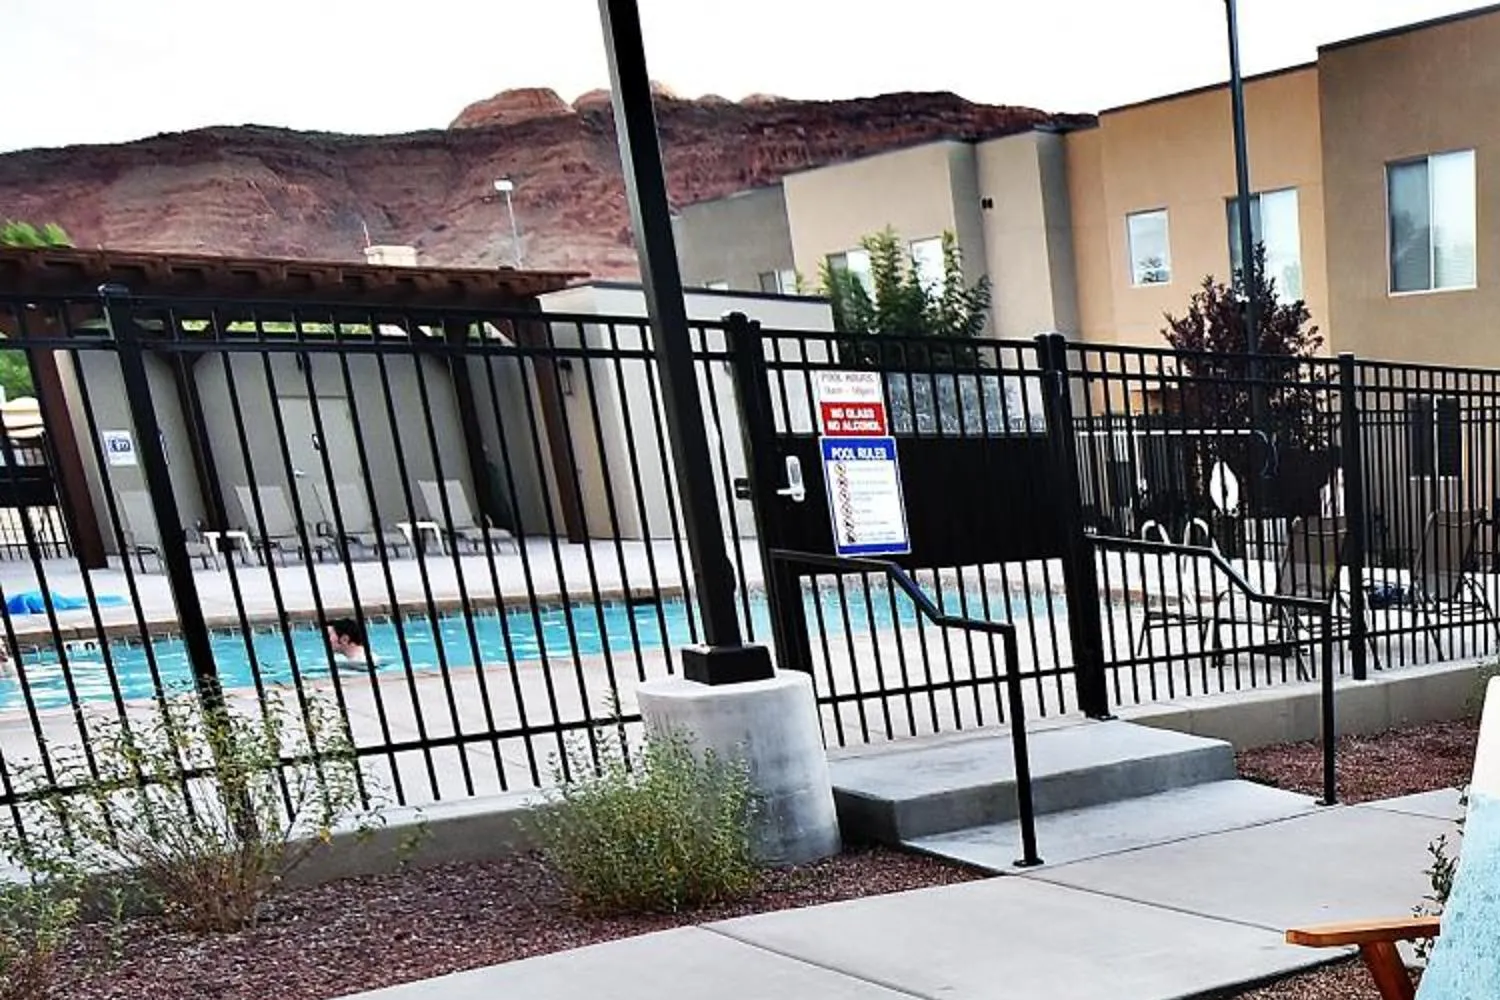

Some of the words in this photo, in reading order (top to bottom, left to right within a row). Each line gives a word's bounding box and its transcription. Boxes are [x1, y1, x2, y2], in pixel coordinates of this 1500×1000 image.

[830, 407, 844, 419] NO
[845, 407, 875, 419] GLASS
[827, 420, 840, 431] NO
[842, 420, 882, 431] ALCOHOL
[831, 446, 856, 459] POOL
[857, 447, 887, 459] RULES
